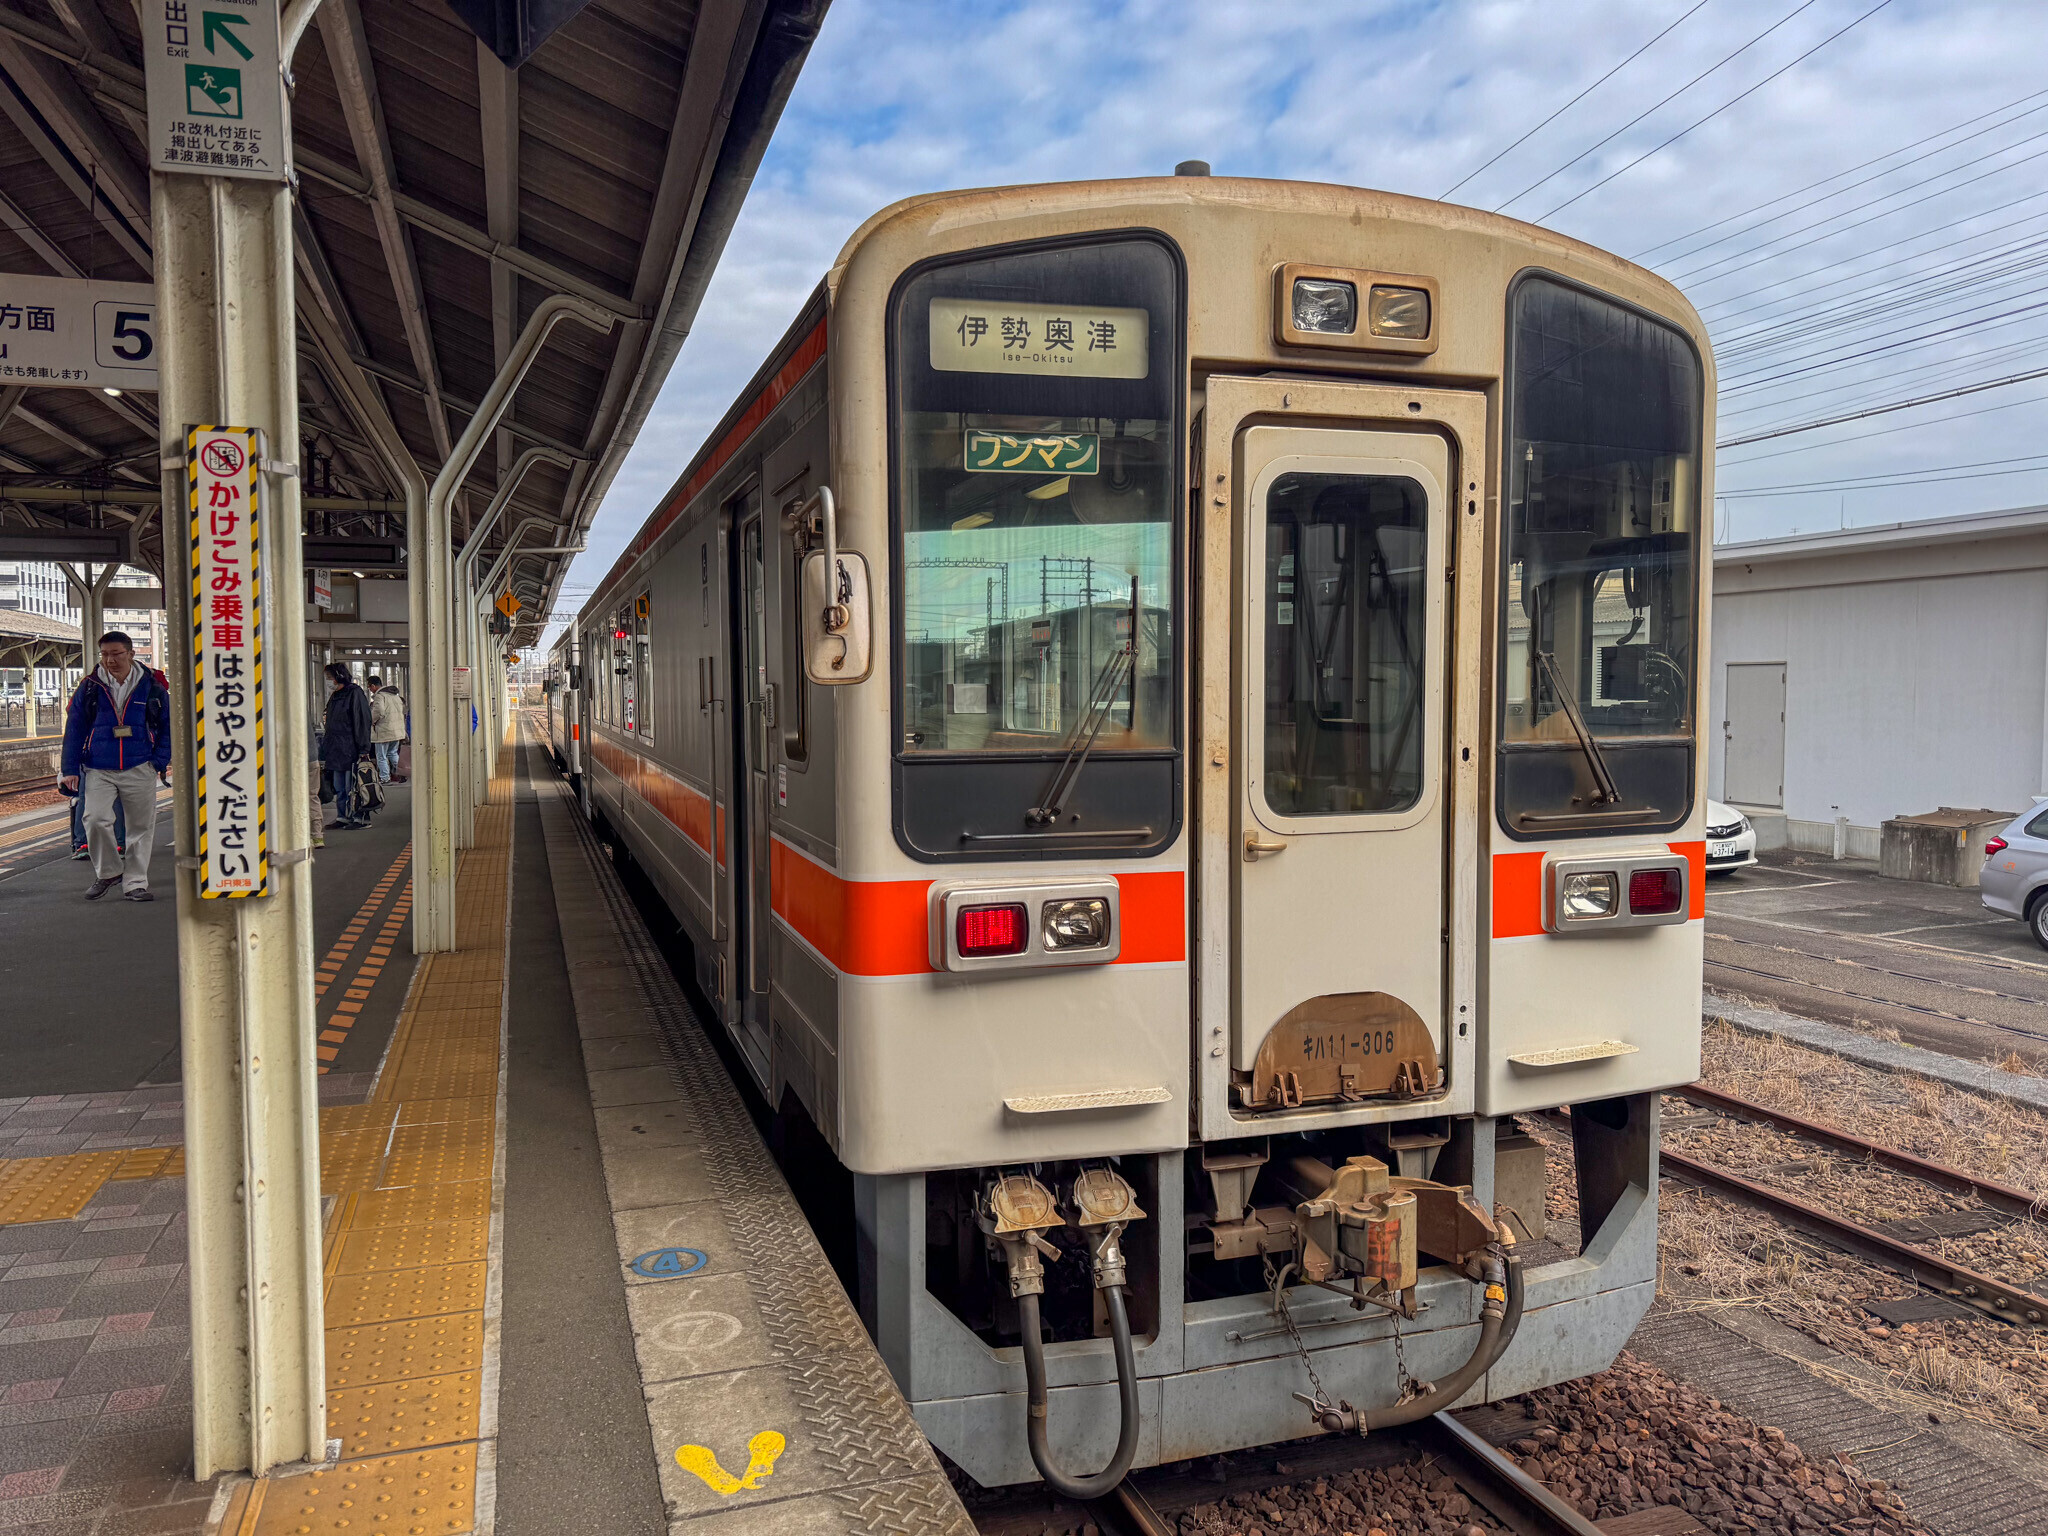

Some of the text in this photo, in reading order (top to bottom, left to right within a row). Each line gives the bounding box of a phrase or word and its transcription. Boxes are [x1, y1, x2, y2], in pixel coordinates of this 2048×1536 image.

[166, 0, 188, 46] 出口
[167, 47, 189, 58] Exit
[169, 121, 262, 141] JR改札付近に
[172, 135, 260, 154] 掲出してある
[164, 148, 268, 168] 津波避難場所へ
[112, 311, 153, 361] 5
[957, 315, 1117, 353] 伊勢奥津
[1002, 352, 1074, 364] Ise-Okitsu
[0, 365, 89, 381] きも発車します)
[971, 436, 1095, 469] ワンマン
[506, 597, 510, 612] 1
[216, 879, 252, 888] JR東海
[1303, 1030, 1394, 1061] キハ11-306
